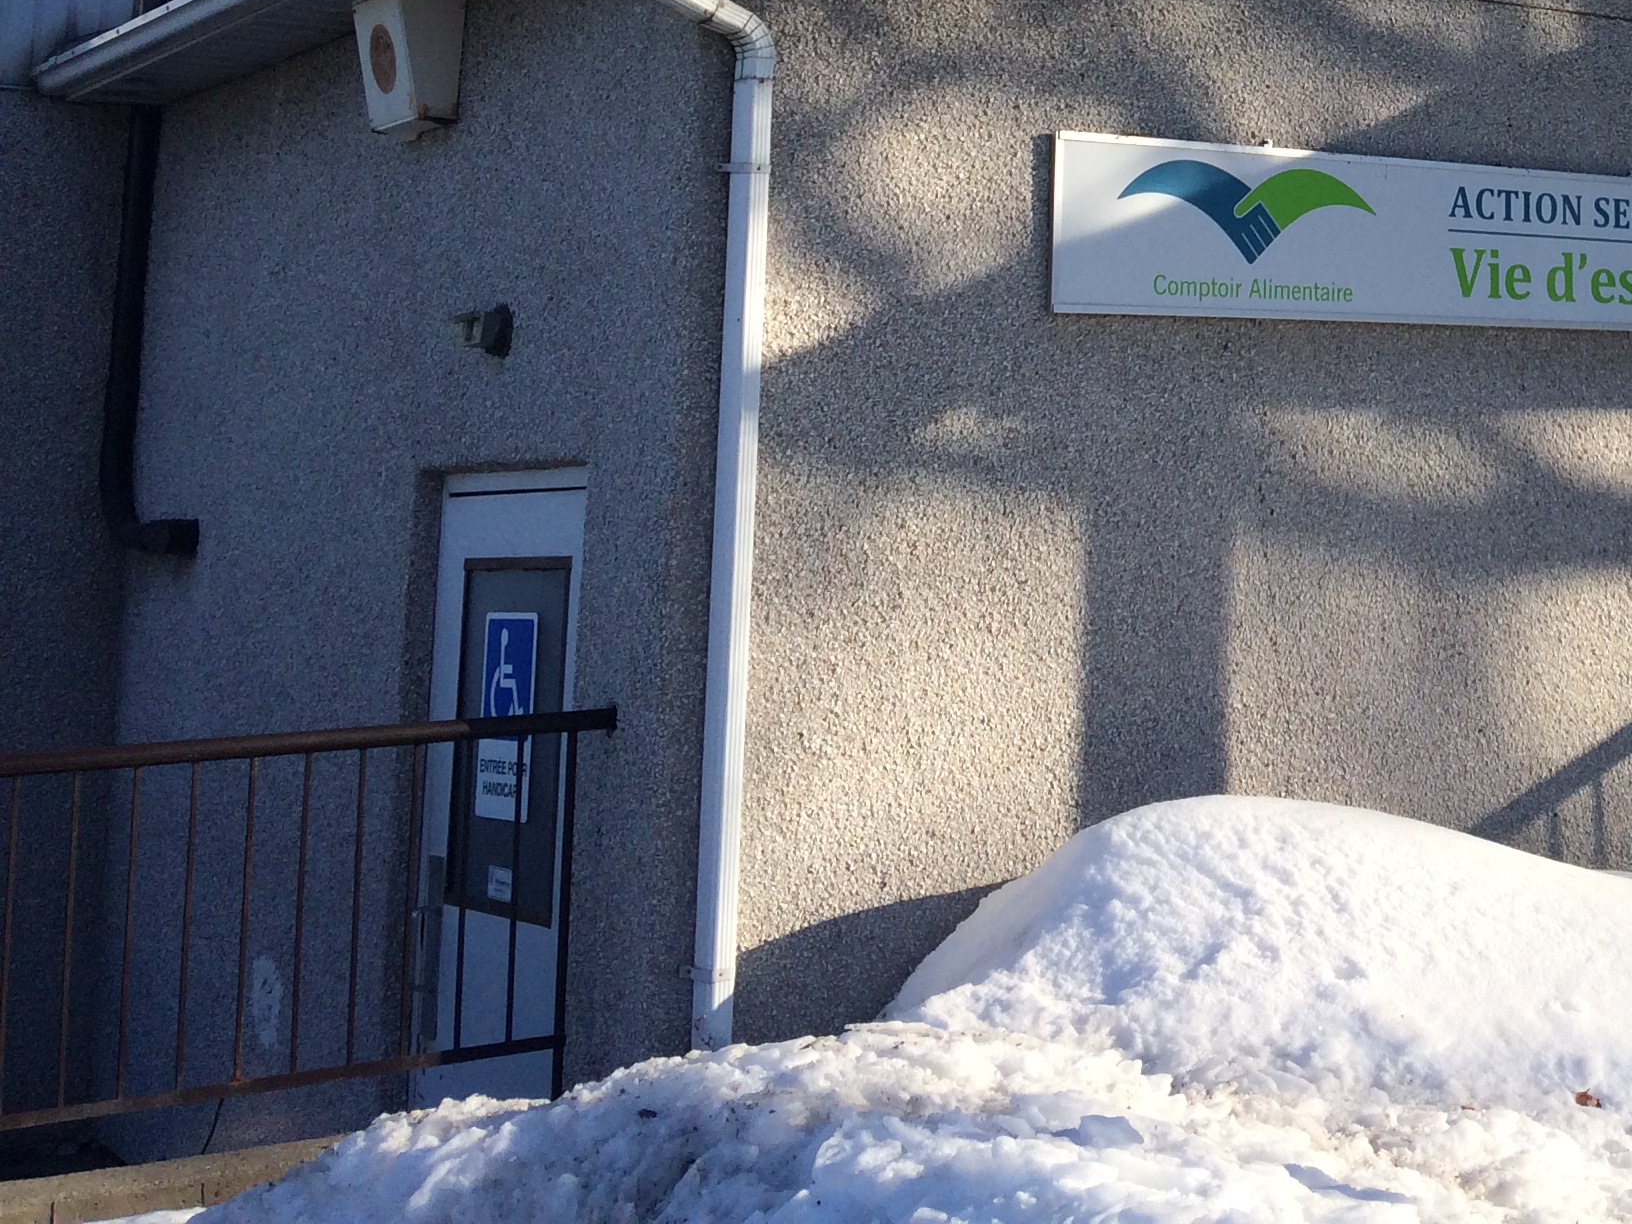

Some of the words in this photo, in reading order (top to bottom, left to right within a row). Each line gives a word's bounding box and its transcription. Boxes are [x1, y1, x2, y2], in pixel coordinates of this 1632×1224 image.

[1449, 186, 1582, 226] ACTION
[1153, 274, 1243, 302] Comptoir
[1249, 278, 1353, 302] Alimentaire
[1450, 247, 1532, 300] Vie
[480, 757, 507, 775] ENTRÉE
[508, 761, 528, 778] POR
